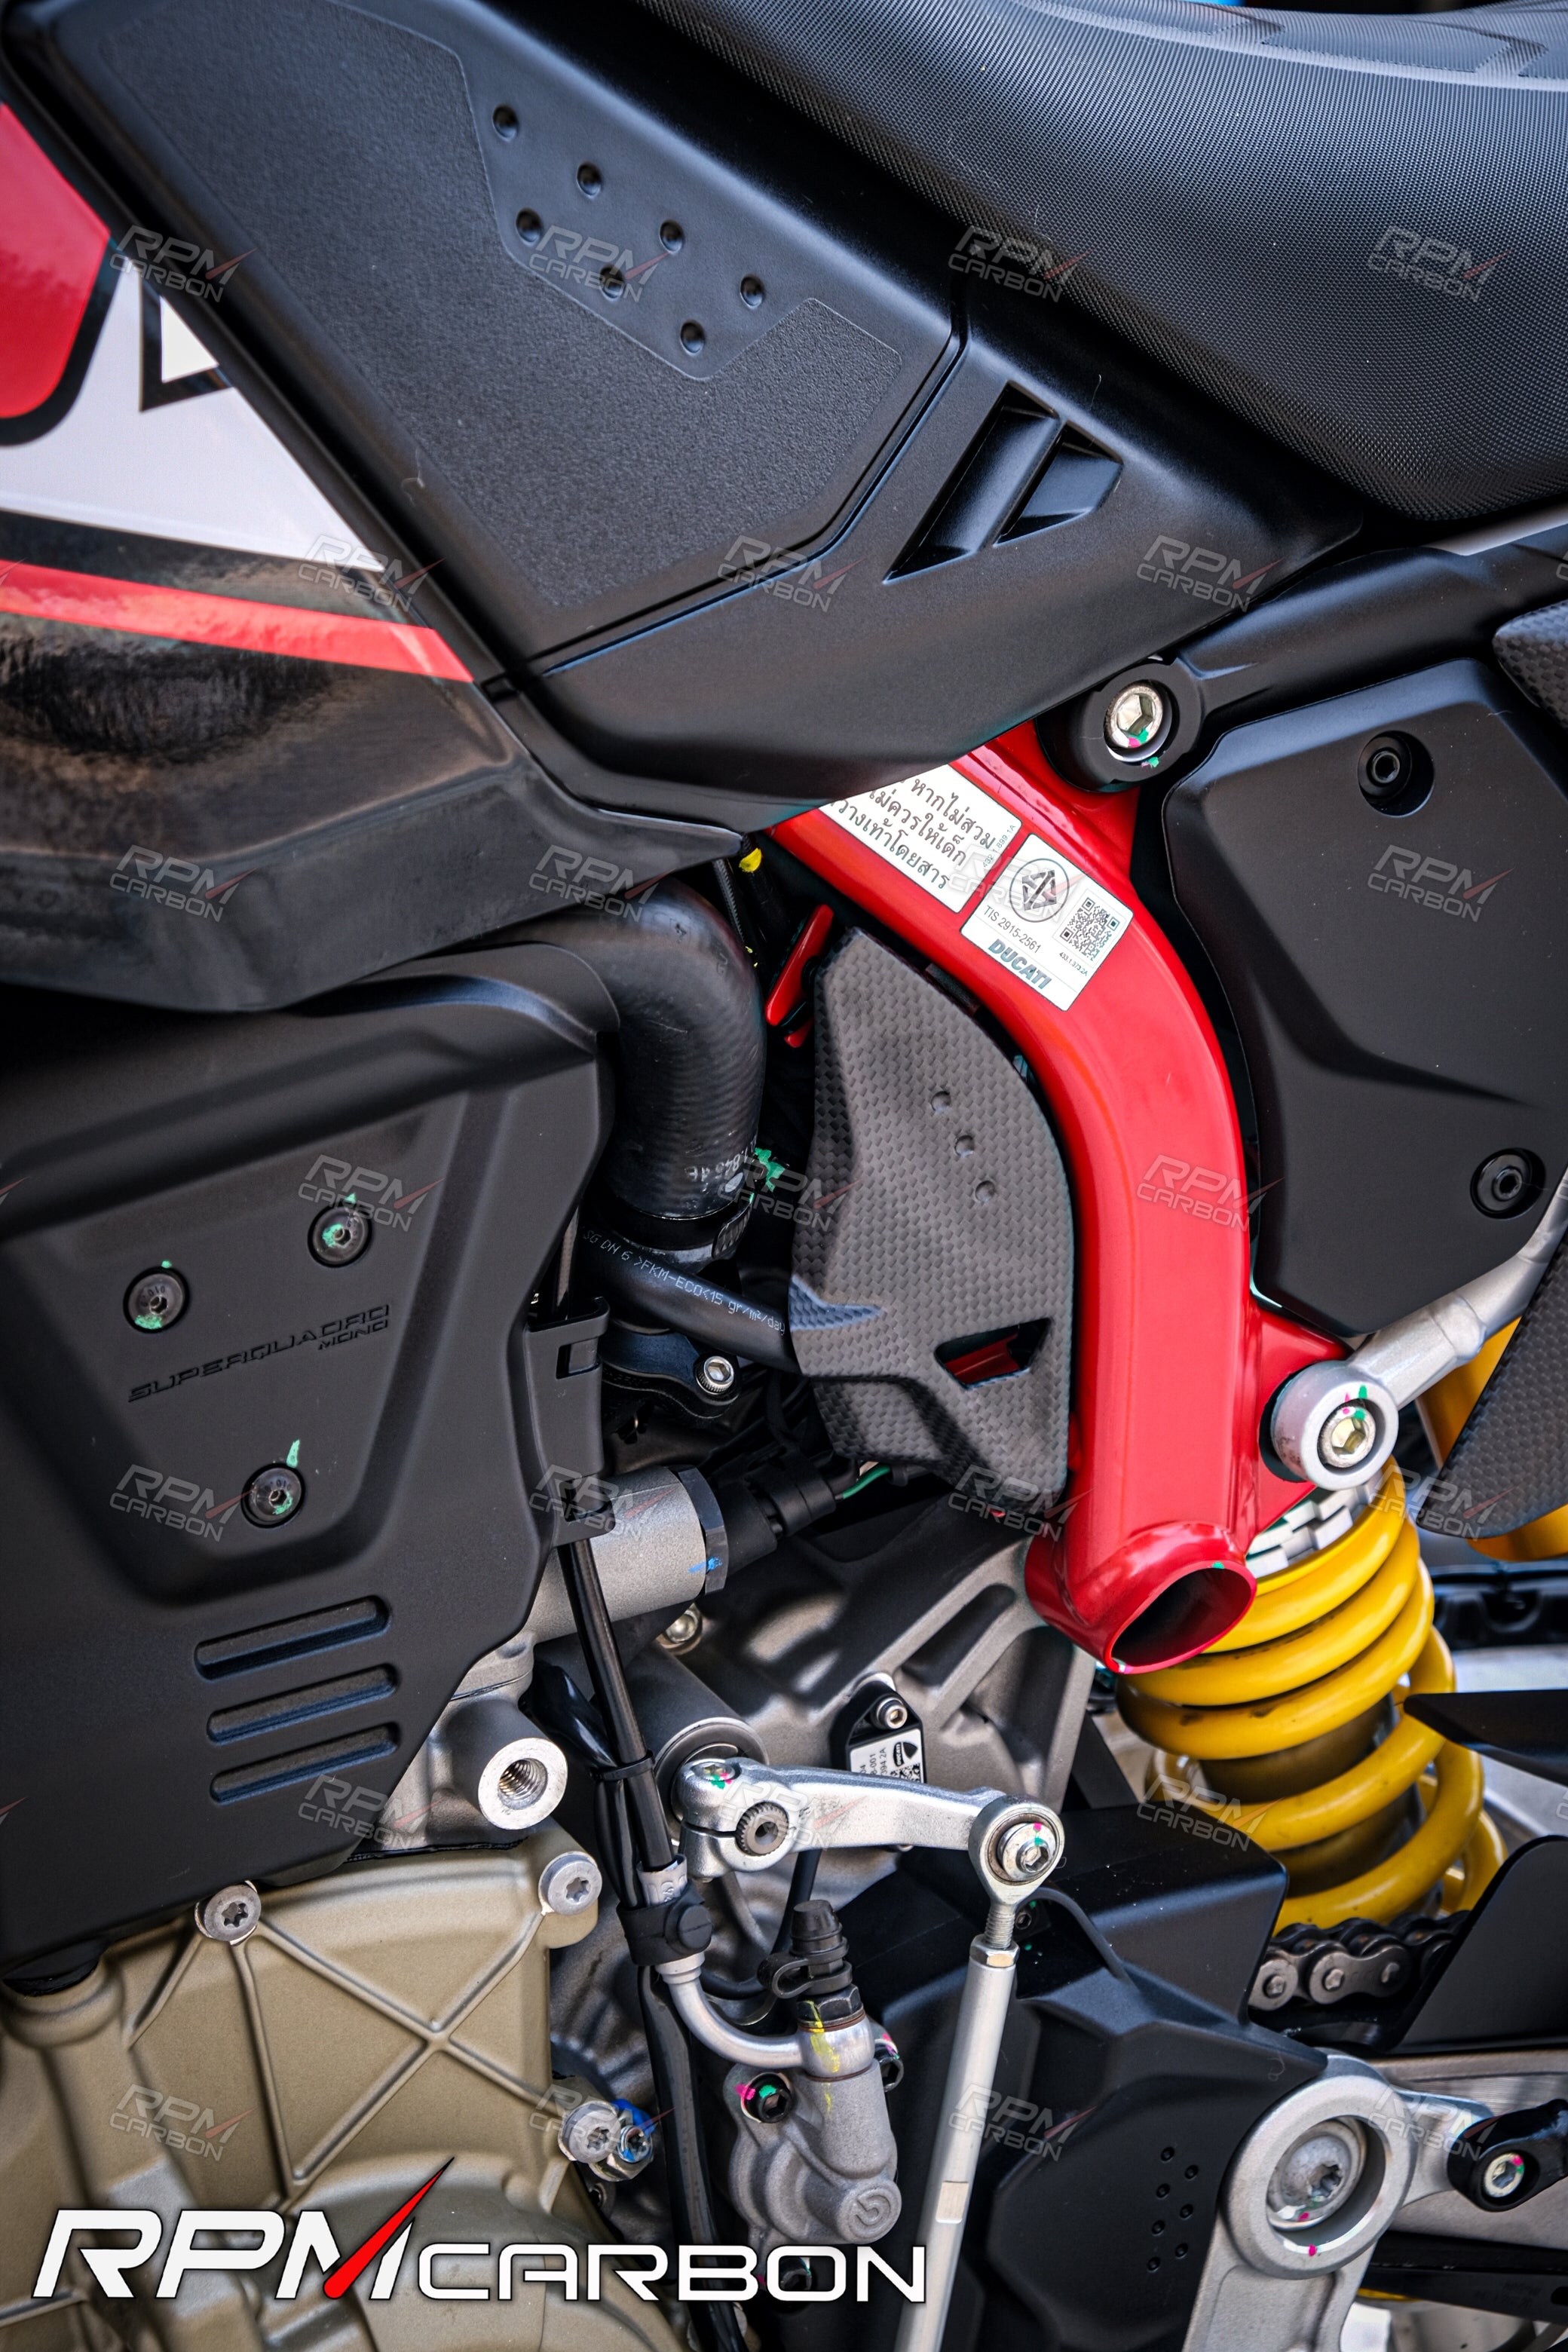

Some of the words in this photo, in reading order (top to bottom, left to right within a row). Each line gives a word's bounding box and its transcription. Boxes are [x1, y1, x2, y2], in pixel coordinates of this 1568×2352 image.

[911, 779, 996, 849] หากไม่สวม
[829, 799, 951, 889] วางเท้าโดยสาร
[983, 905, 1000, 922] TIS
[997, 917, 1042, 954] 2915-2561
[988, 939, 1052, 990] DUCATI
[600, 1239, 618, 1255] DN
[621, 1251, 634, 1261] 6
[128, 1304, 390, 1402] SUPERQUADRO
[317, 1319, 389, 1350] MONO
